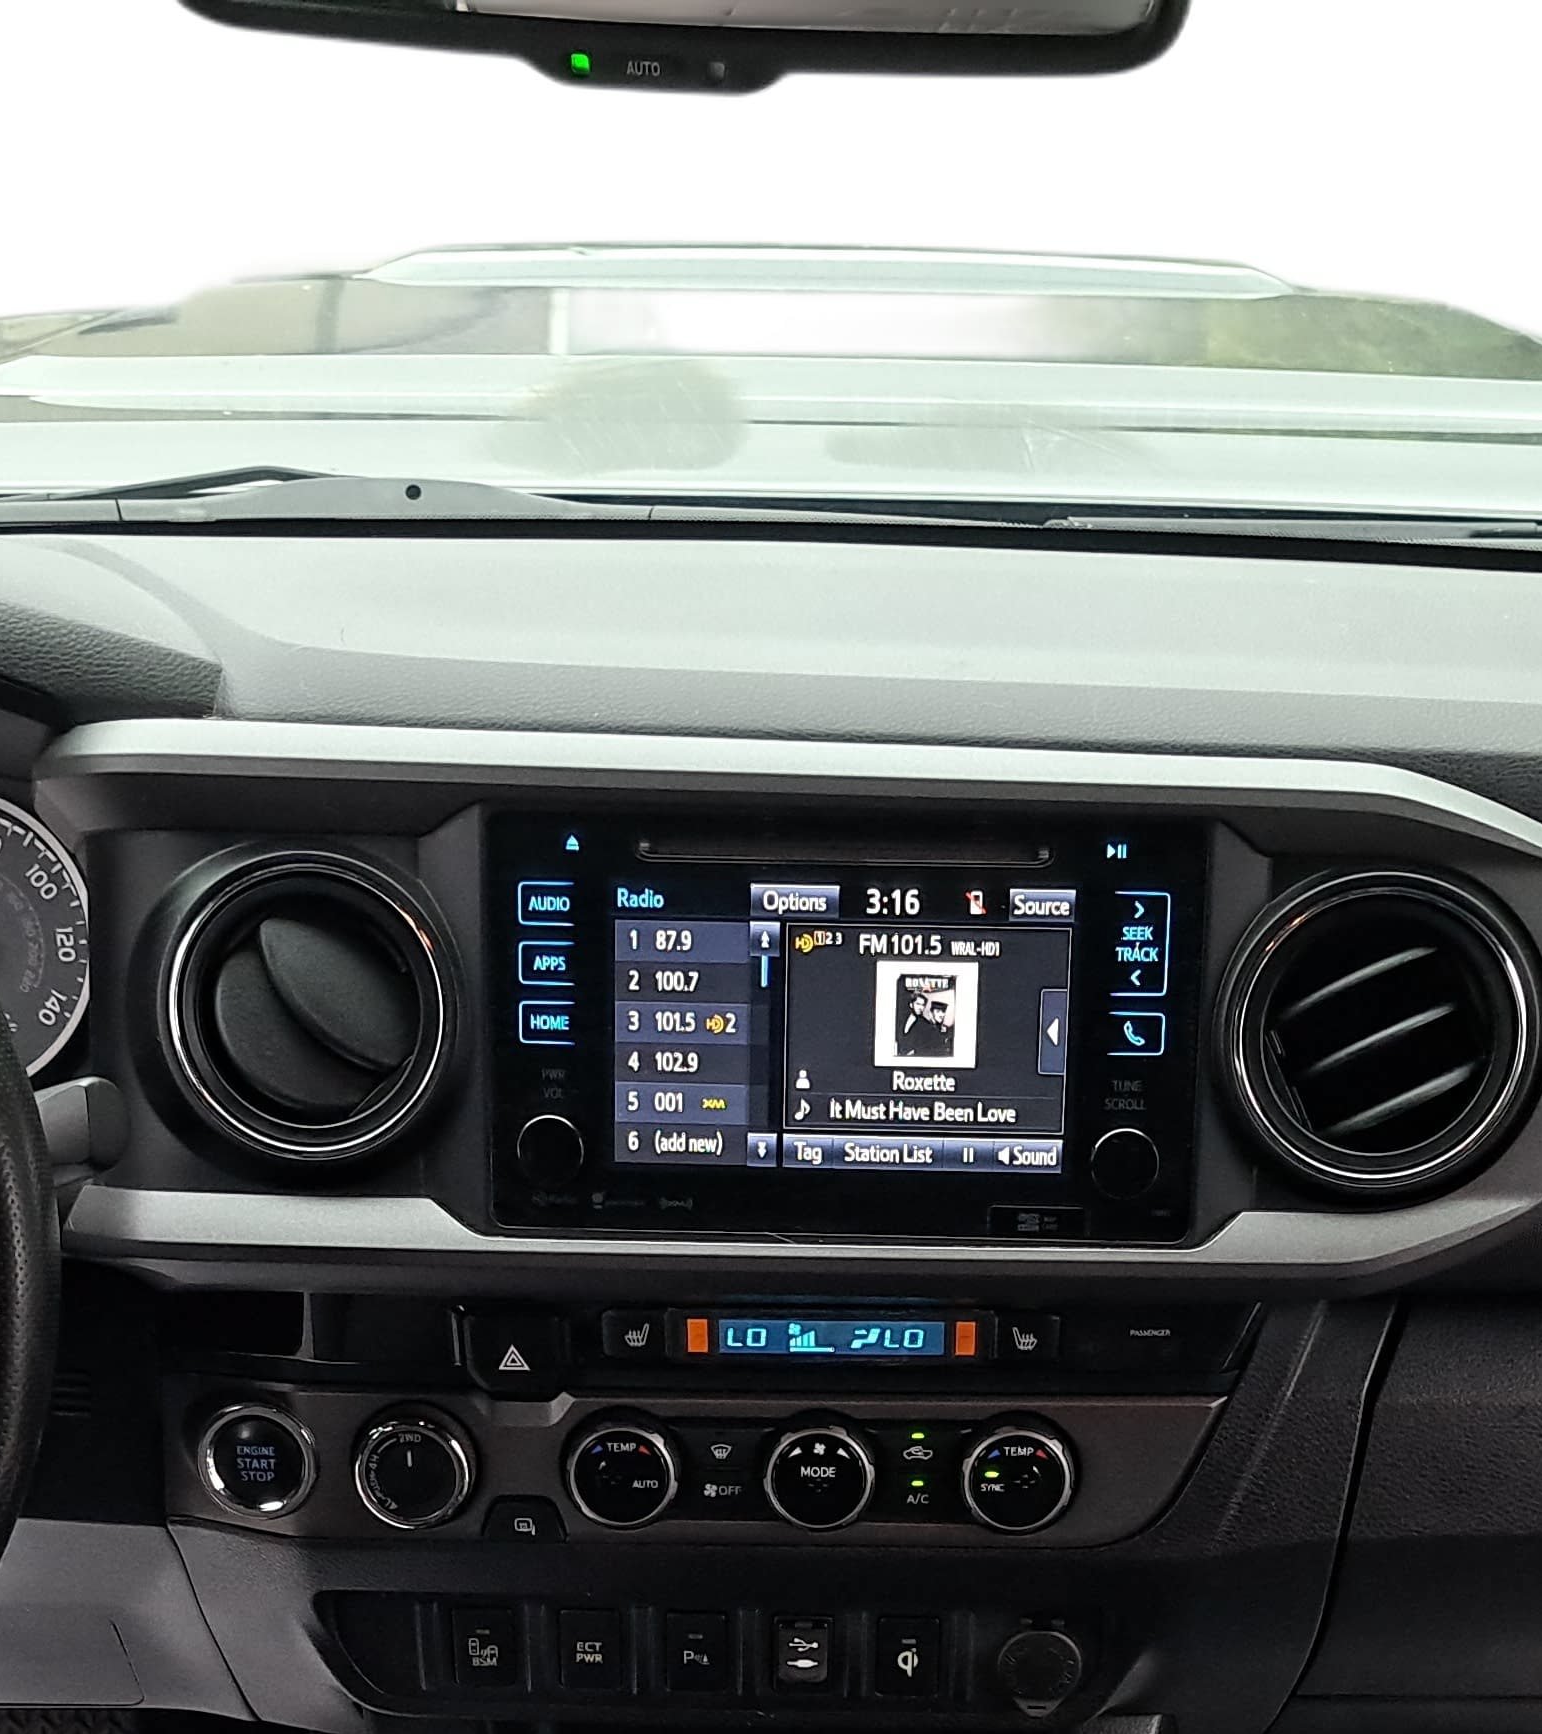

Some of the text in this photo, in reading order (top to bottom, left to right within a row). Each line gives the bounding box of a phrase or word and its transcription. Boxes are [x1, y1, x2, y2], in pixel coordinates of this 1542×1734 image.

[627, 60, 661, 77] AUTO
[25, 863, 58, 900] 100
[528, 896, 570, 912] AUDIO
[617, 888, 665, 908] Radio
[763, 890, 827, 914] Options
[866, 888, 920, 915] 3:16
[1013, 895, 1070, 916] Source
[629, 930, 692, 951] 1 87.9
[1122, 926, 1153, 940] SEEK
[55, 926, 77, 962] 120
[859, 933, 1000, 956] FM 101.5 WRAL-HD1
[1115, 945, 1159, 962] TRACK
[533, 955, 566, 971] APPS
[628, 971, 699, 991] 2 100.7
[38, 989, 68, 1026] 140
[530, 1014, 570, 1031] HOME
[628, 1011, 640, 1031] 3
[655, 1012, 696, 1032] 101.5
[628, 1052, 699, 1072] 4 102.9
[892, 1071, 956, 1091] Roxette
[1112, 1080, 1143, 1092] TUNE
[628, 1091, 639, 1111] 5
[654, 1092, 683, 1112] 001
[829, 1098, 1016, 1123] It Must Have Been Love
[1105, 1098, 1147, 1110] SCROLL
[628, 1130, 723, 1155] 6 (add new)
[793, 1142, 822, 1164] Tag
[844, 1143, 933, 1164] Station List
[1012, 1146, 1057, 1166] Sound
[727, 1327, 767, 1347] LO
[883, 1329, 925, 1348] LO
[236, 1445, 275, 1457] ENGINE
[605, 1442, 637, 1454] TEMP
[1003, 1446, 1035, 1458] TEMP
[236, 1458, 276, 1470] START
[800, 1466, 836, 1479] MODE
[240, 1470, 275, 1482] STOP
[632, 1479, 659, 1489] AUTO
[718, 1485, 742, 1497] OFF
[981, 1483, 1005, 1493] SYNC
[906, 1493, 930, 1505] A/C
[576, 1642, 602, 1652] ECT
[472, 1657, 498, 1667] BSM
[576, 1653, 603, 1664] PWR
